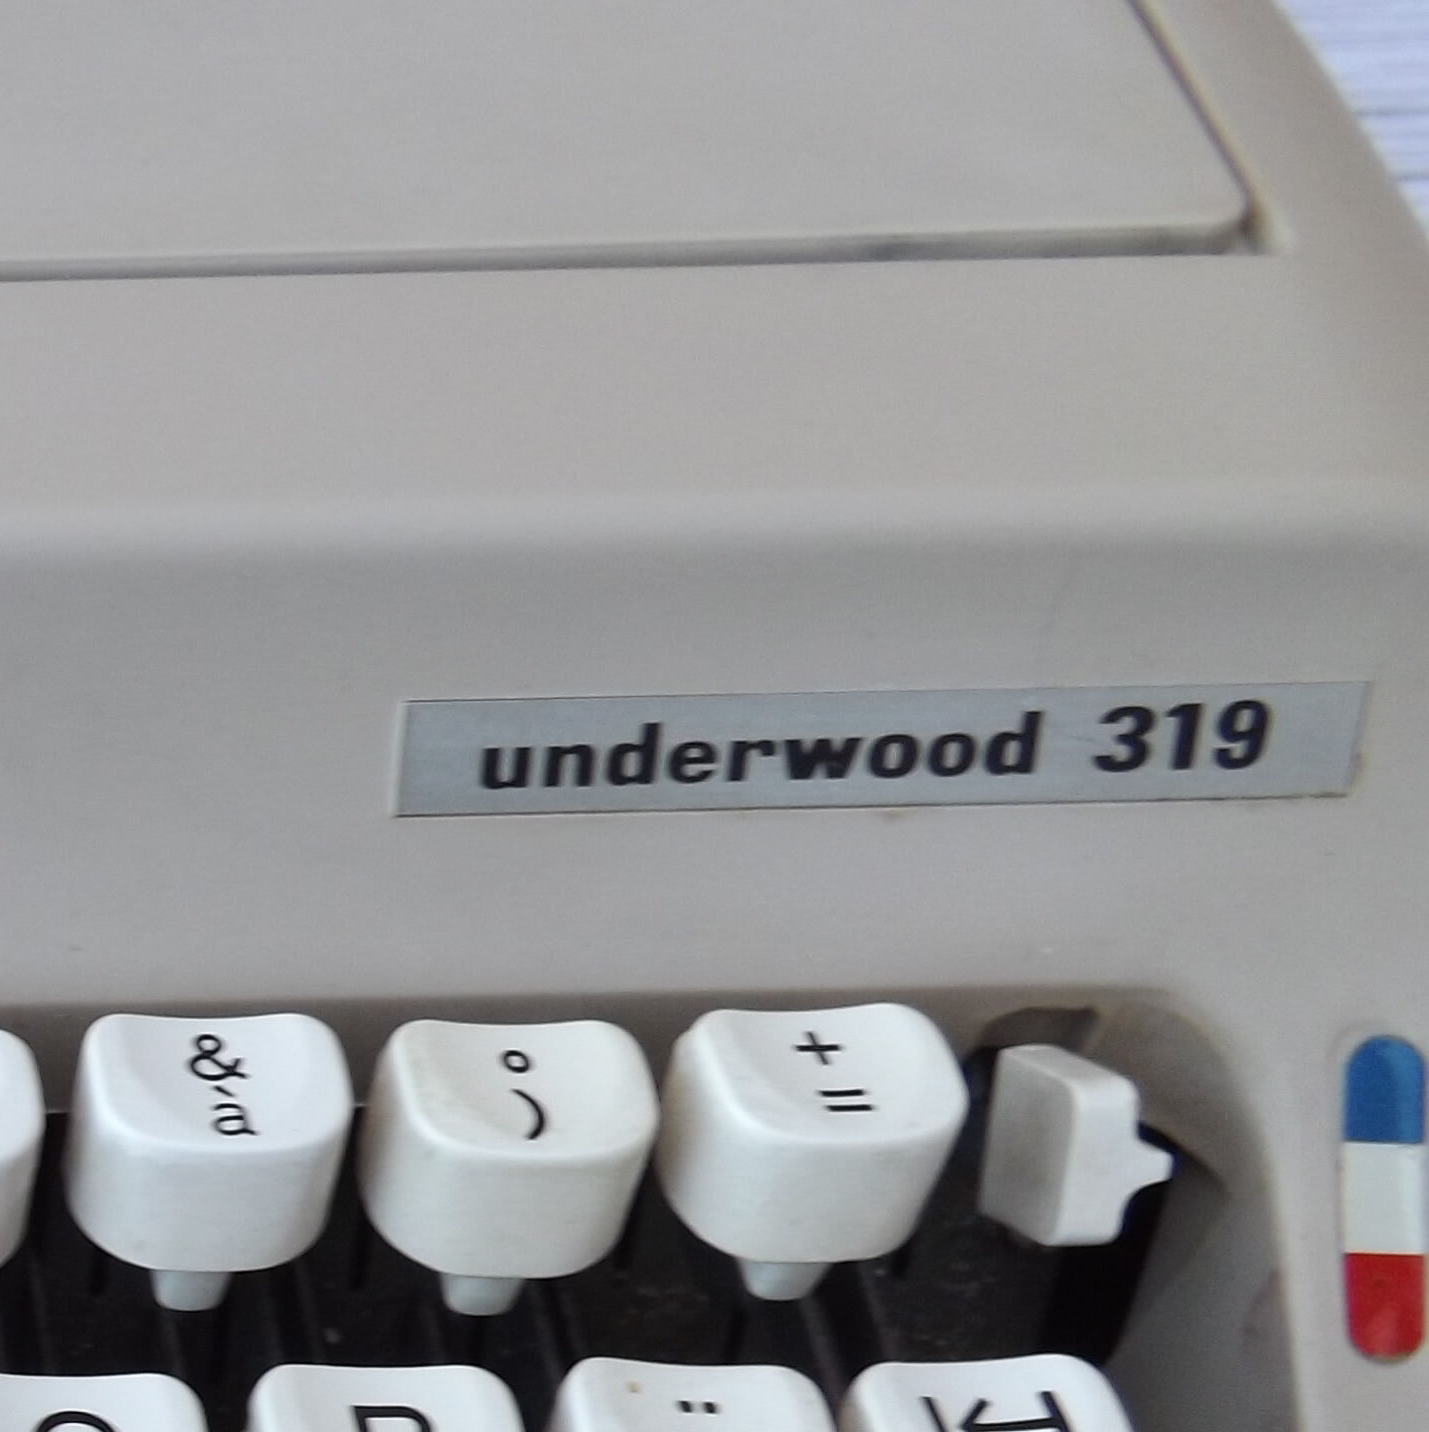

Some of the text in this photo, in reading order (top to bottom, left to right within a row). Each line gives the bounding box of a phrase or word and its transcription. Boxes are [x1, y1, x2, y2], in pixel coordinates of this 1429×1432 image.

[479, 699, 1270, 791] underwood 319
[186, 1032, 249, 1083] &
[793, 1030, 843, 1067] +
[212, 1084, 259, 1137] à
[511, 1087, 548, 1142] )
[817, 1087, 875, 1114] =
